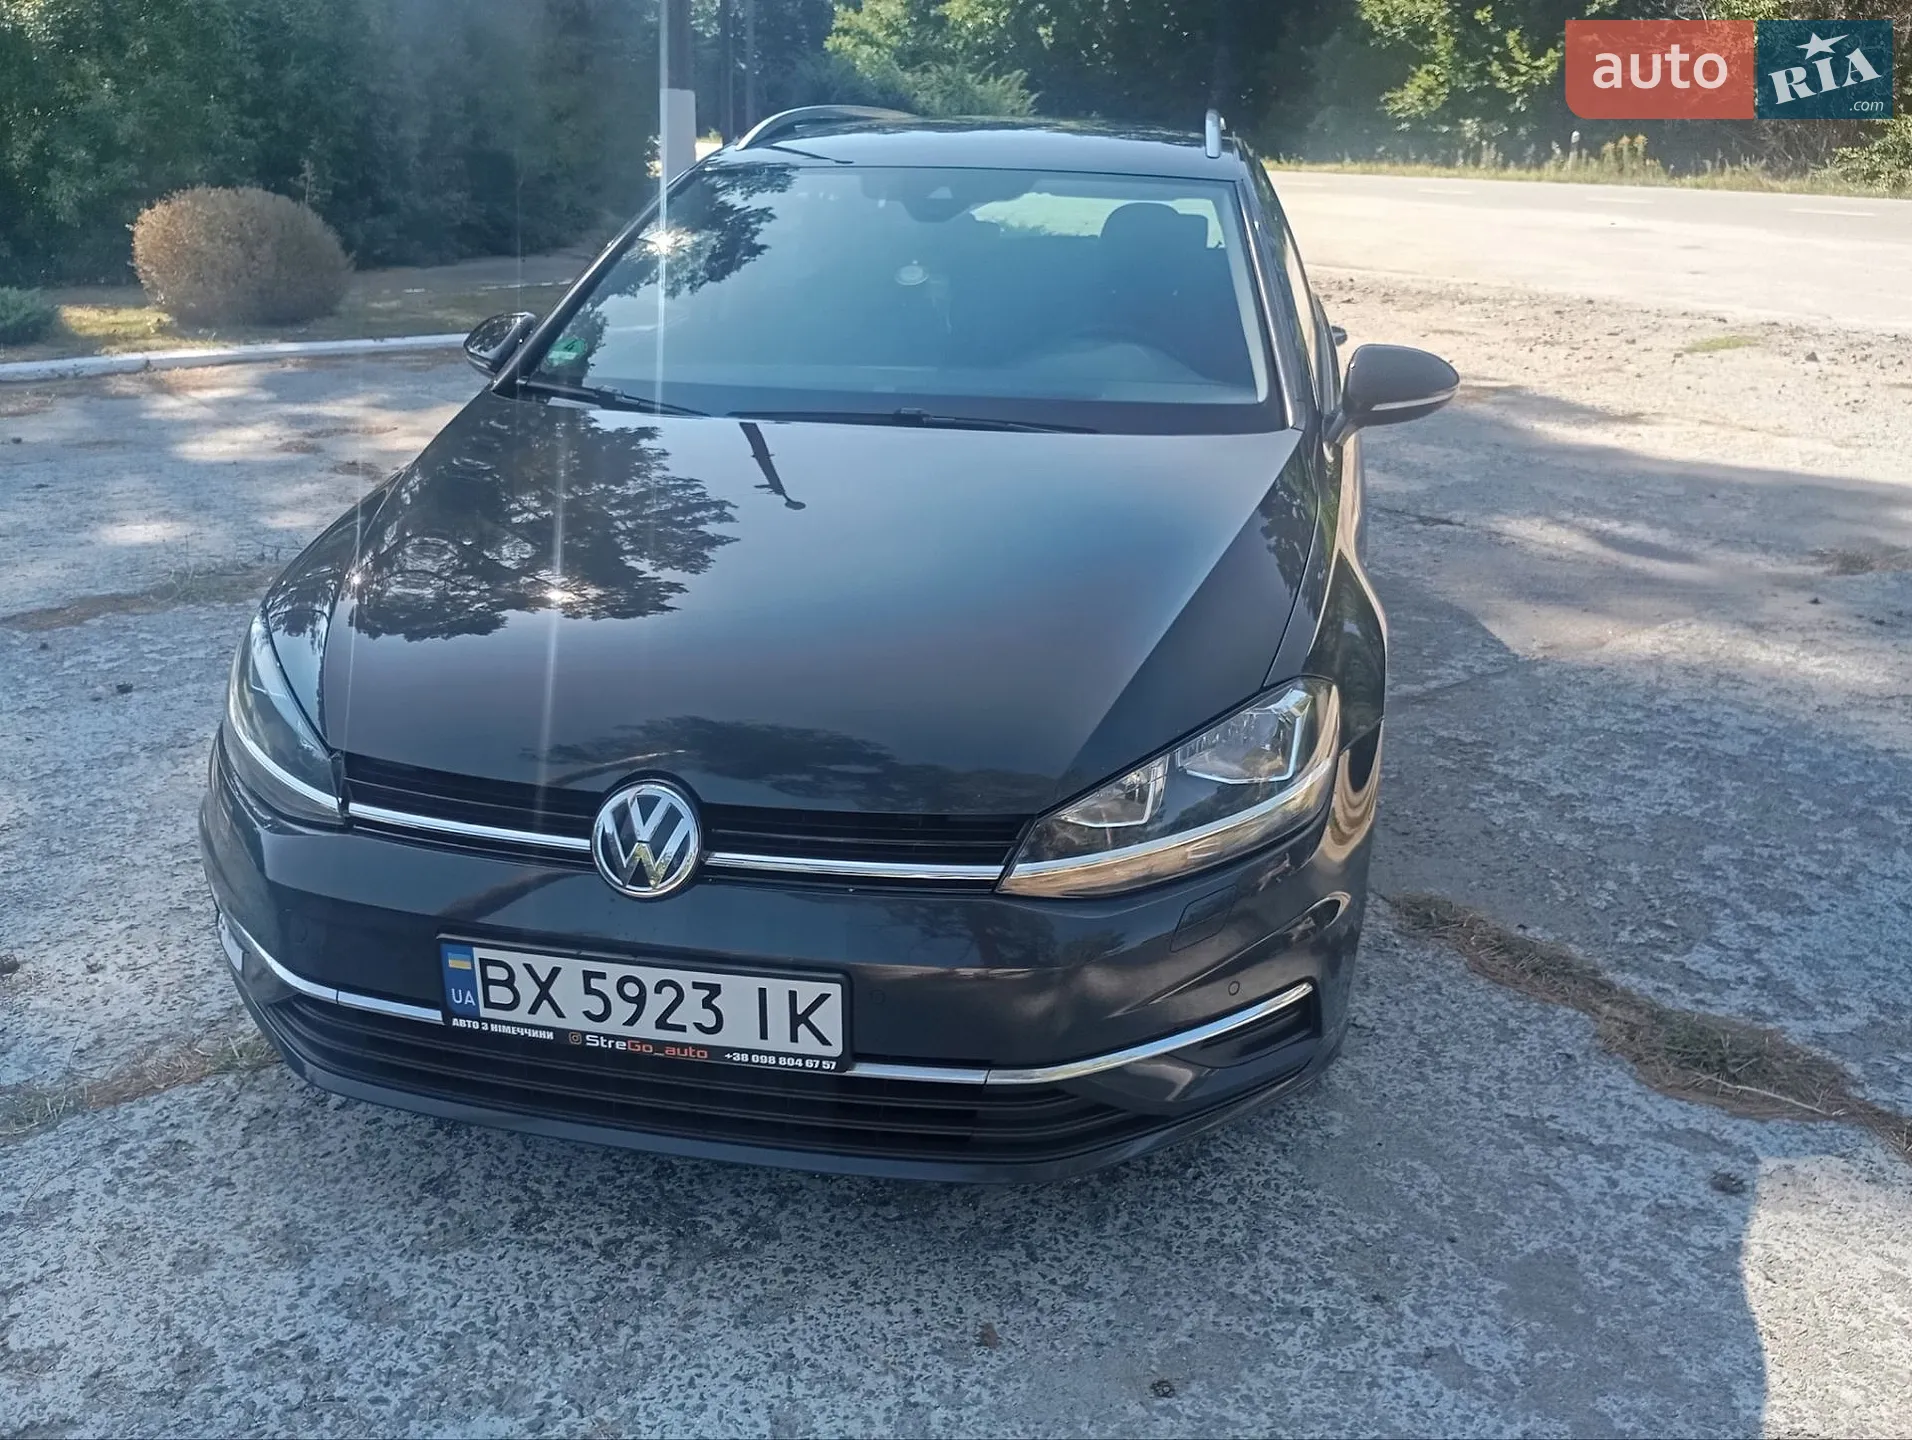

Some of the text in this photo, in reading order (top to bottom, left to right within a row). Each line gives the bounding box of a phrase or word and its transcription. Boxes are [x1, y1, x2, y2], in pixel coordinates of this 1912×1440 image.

[451, 988, 476, 1006] UA
[479, 957, 833, 1047] BX 5923 IK
[452, 1017, 480, 1030] АВТО
[490, 1023, 554, 1041] НІМЕЧЧИНИ
[585, 1034, 709, 1059] StreGo_auto
[724, 1052, 837, 1070] +38 098 804 67 57
